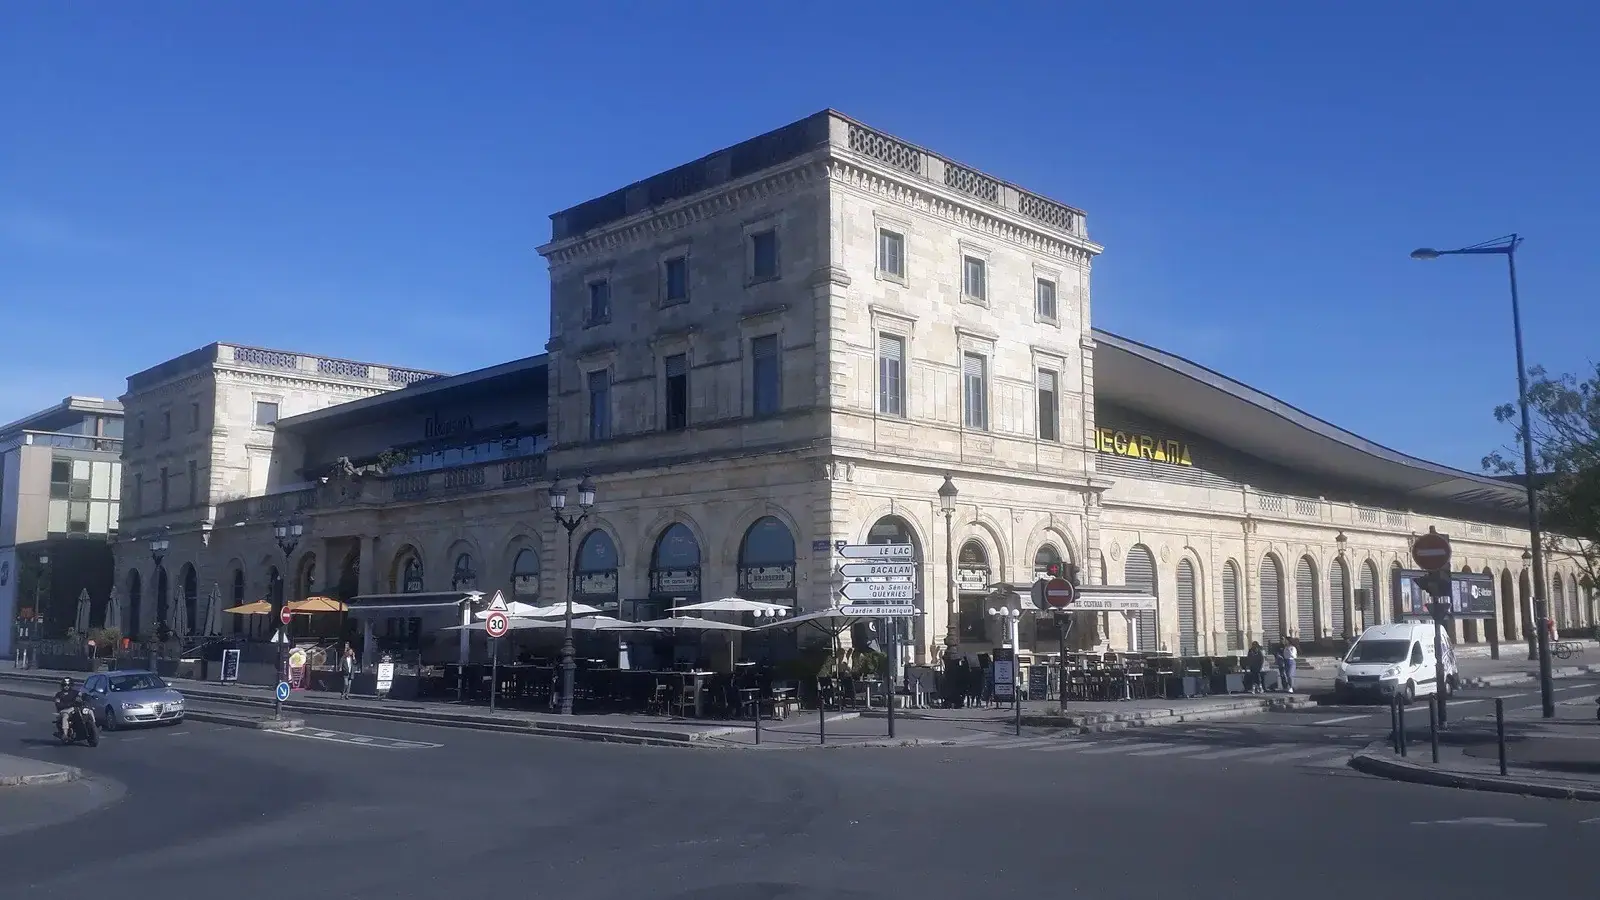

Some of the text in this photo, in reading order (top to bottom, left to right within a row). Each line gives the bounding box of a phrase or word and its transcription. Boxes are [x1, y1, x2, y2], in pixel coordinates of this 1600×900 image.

[879, 547, 910, 555] LE LAC
[870, 566, 911, 574] BACALAN
[876, 607, 912, 615] Botanique
[491, 619, 504, 630] 30
